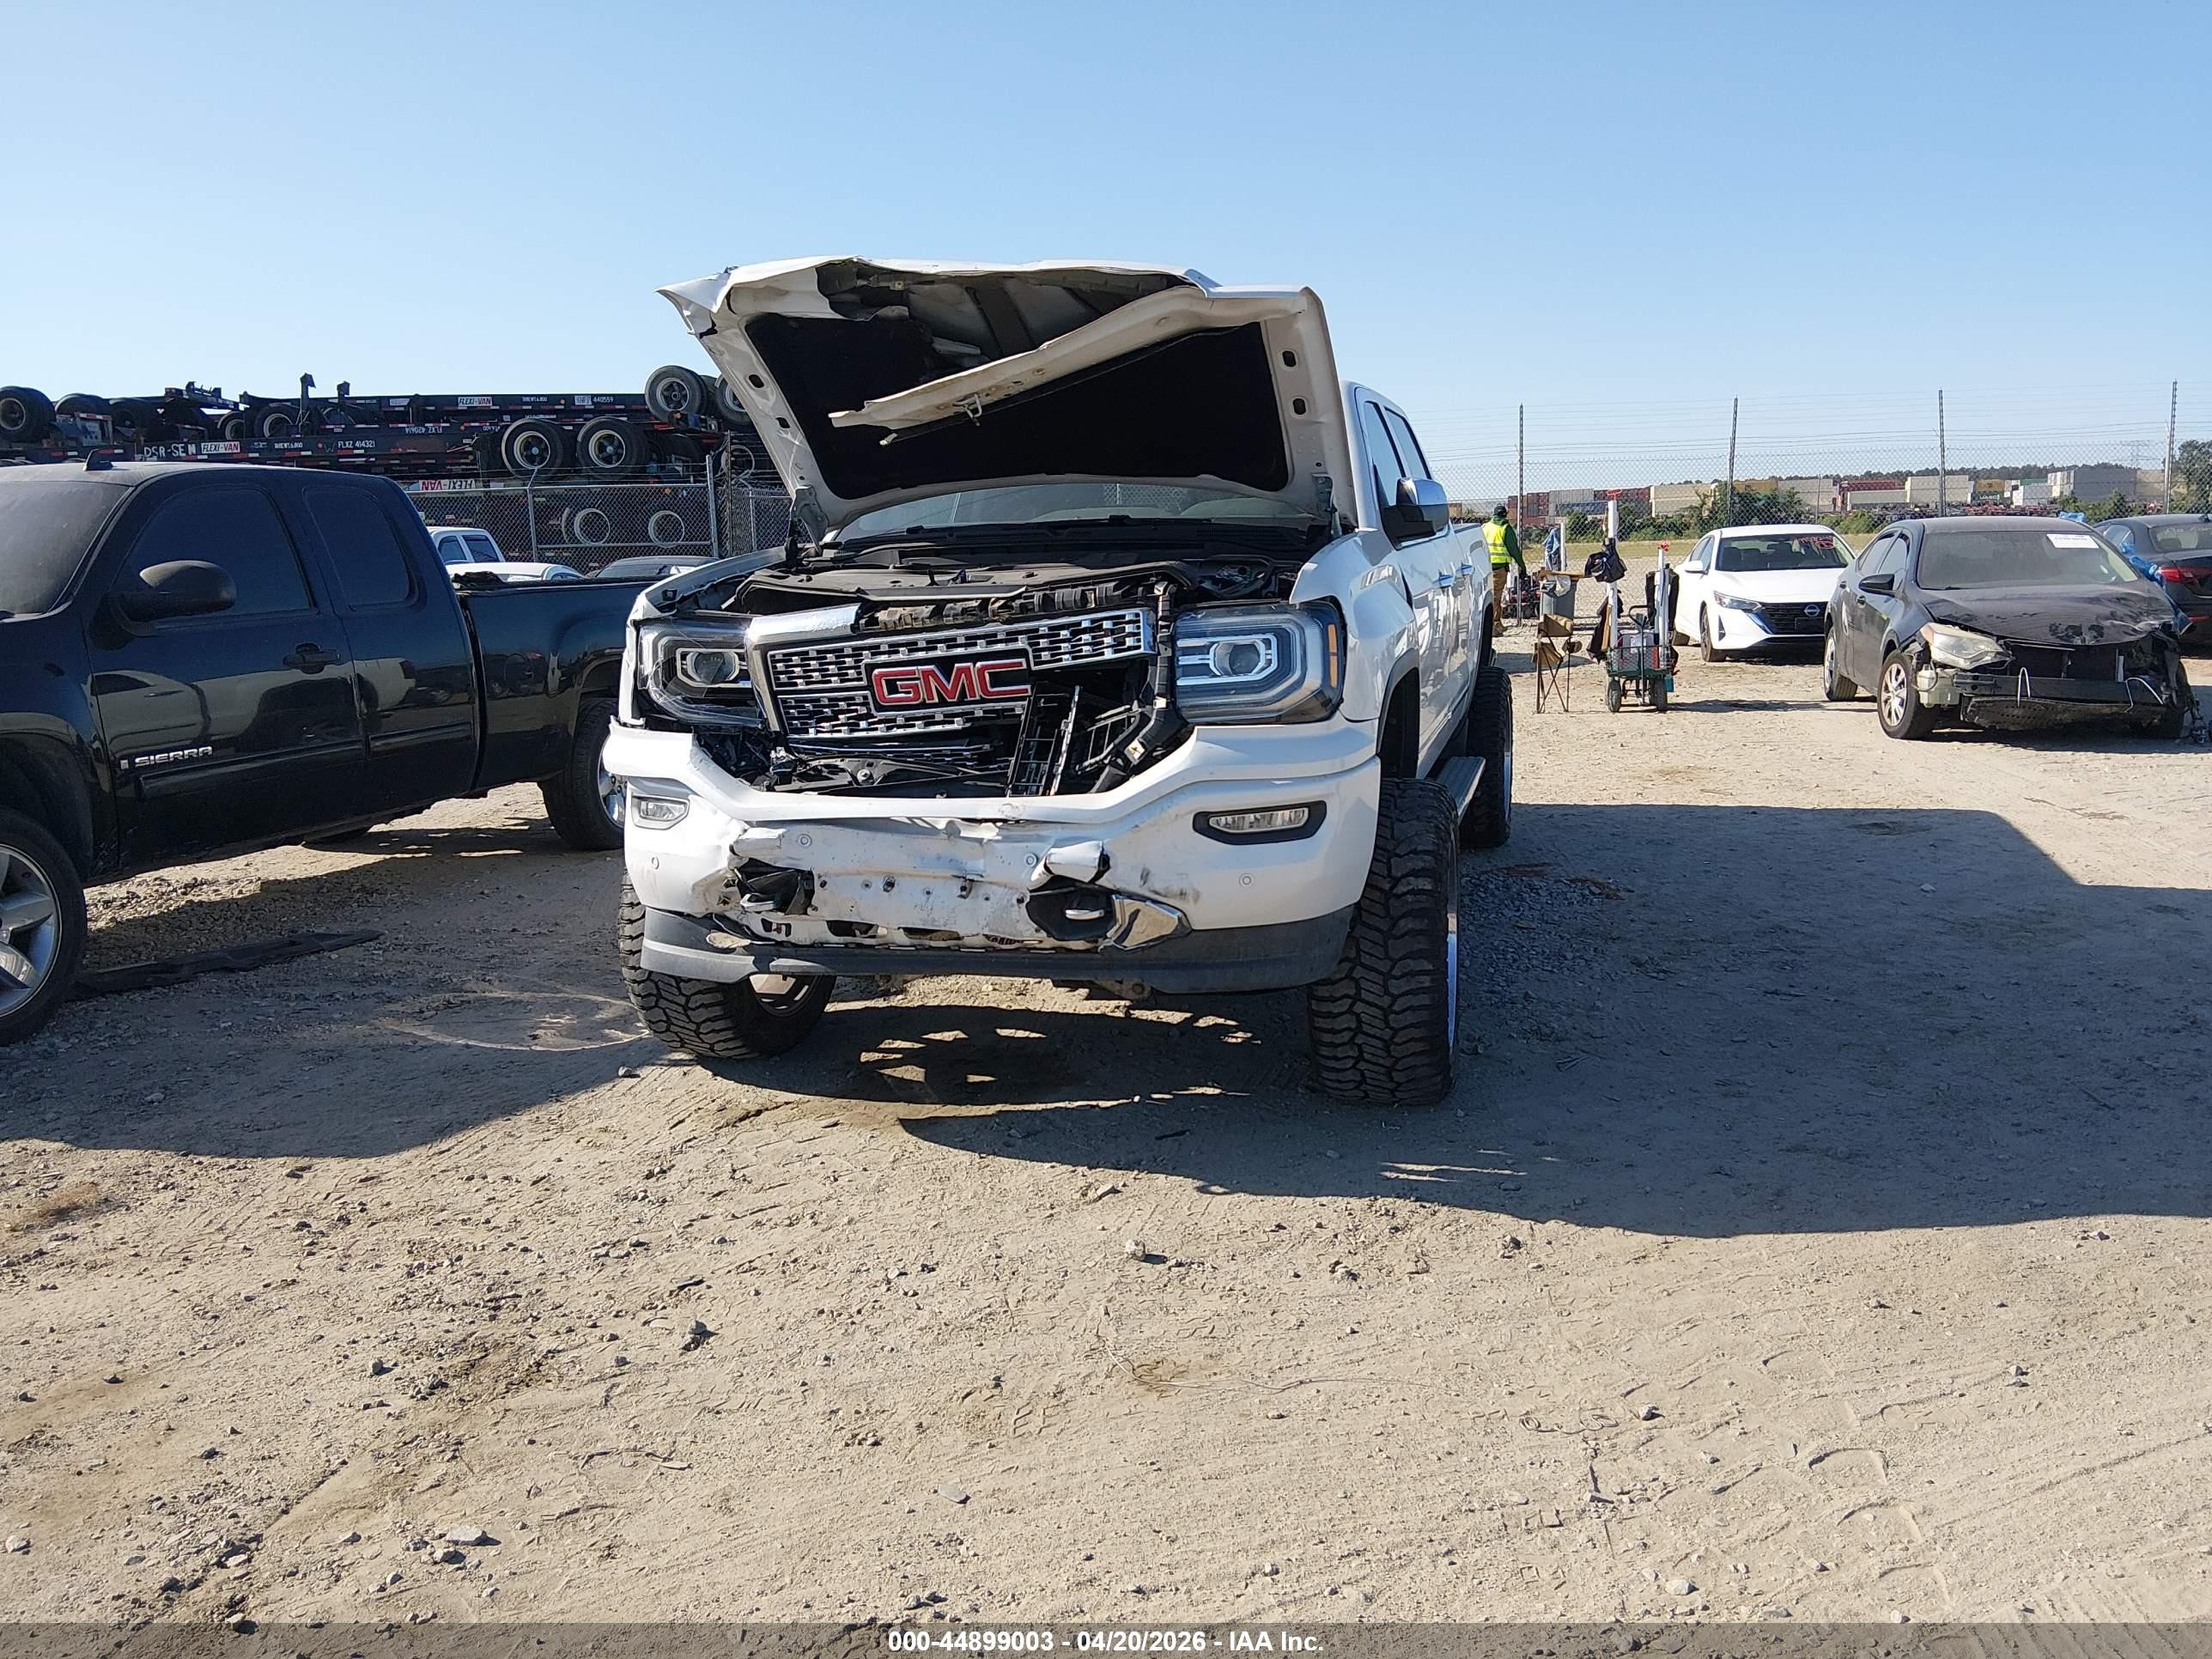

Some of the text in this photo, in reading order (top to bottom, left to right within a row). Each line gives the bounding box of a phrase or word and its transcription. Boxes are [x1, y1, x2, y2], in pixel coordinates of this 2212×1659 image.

[459, 397, 492, 405] FLEXI-VAN
[202, 442, 240, 453] FLEXI-VAN
[355, 440, 375, 448] 414321
[421, 480, 473, 491] FLEXI-VAN
[872, 658, 1031, 706] GMC
[135, 745, 213, 768] SIERRA
